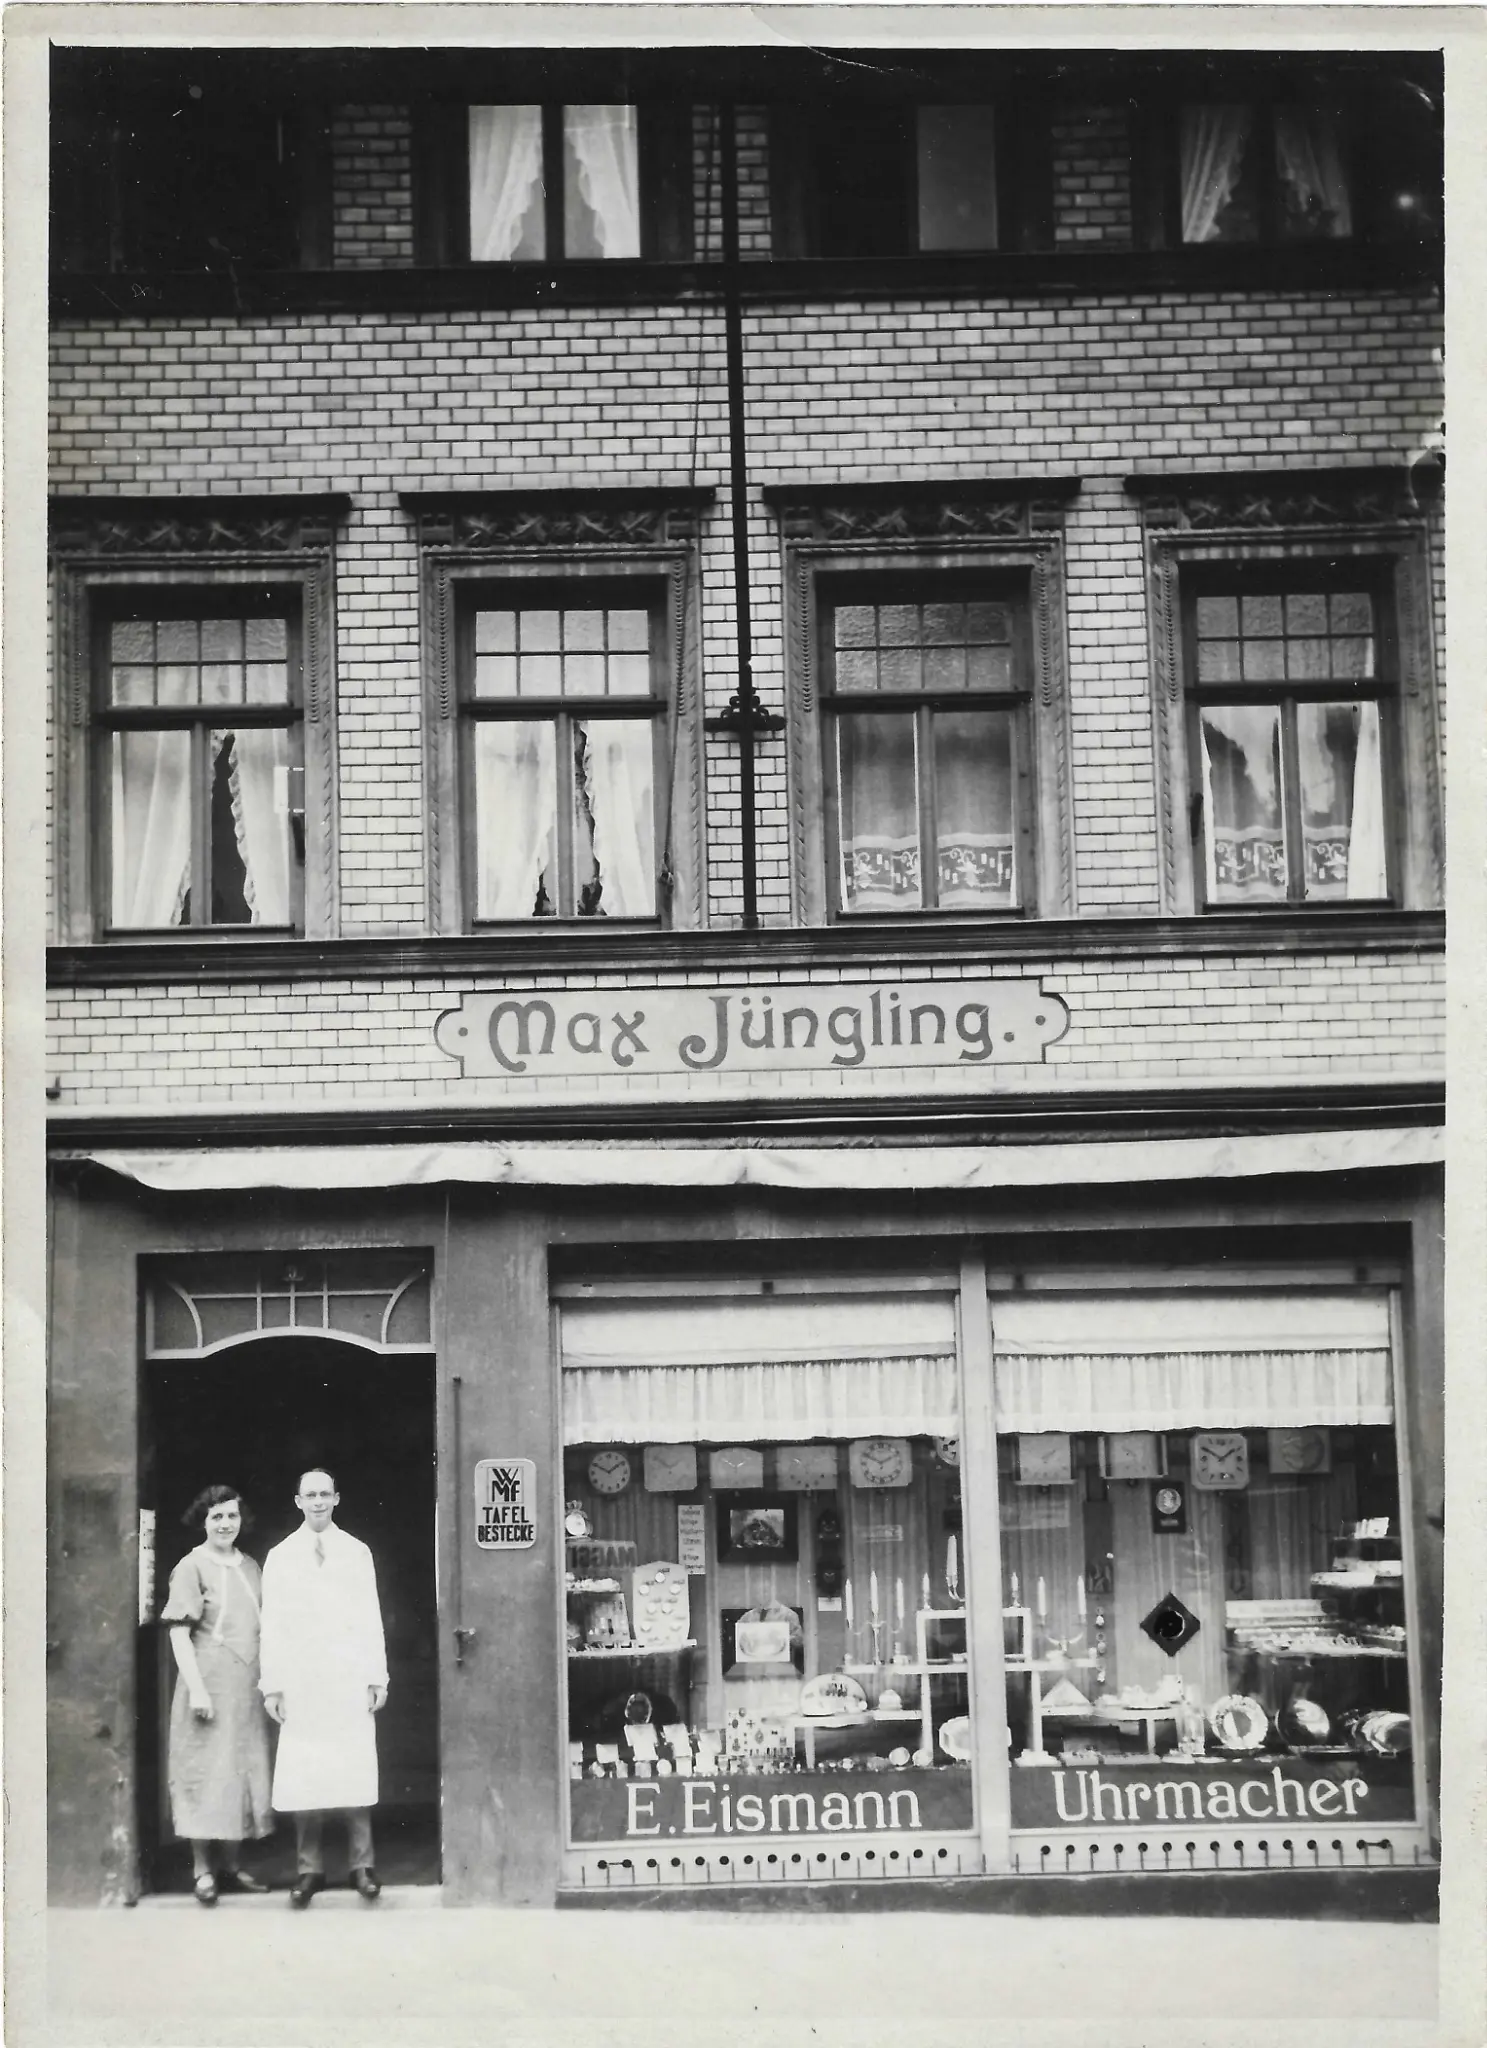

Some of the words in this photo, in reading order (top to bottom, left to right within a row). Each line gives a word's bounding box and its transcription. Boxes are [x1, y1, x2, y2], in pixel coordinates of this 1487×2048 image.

[488, 999, 649, 1073] Max
[679, 989, 1015, 1069] Jüngling.
[491, 1468, 520, 1502] WMF
[482, 1506, 529, 1523] TAFEL
[478, 1525, 534, 1542] BESTECKE
[1051, 1766, 1369, 1821] Uhrmacher
